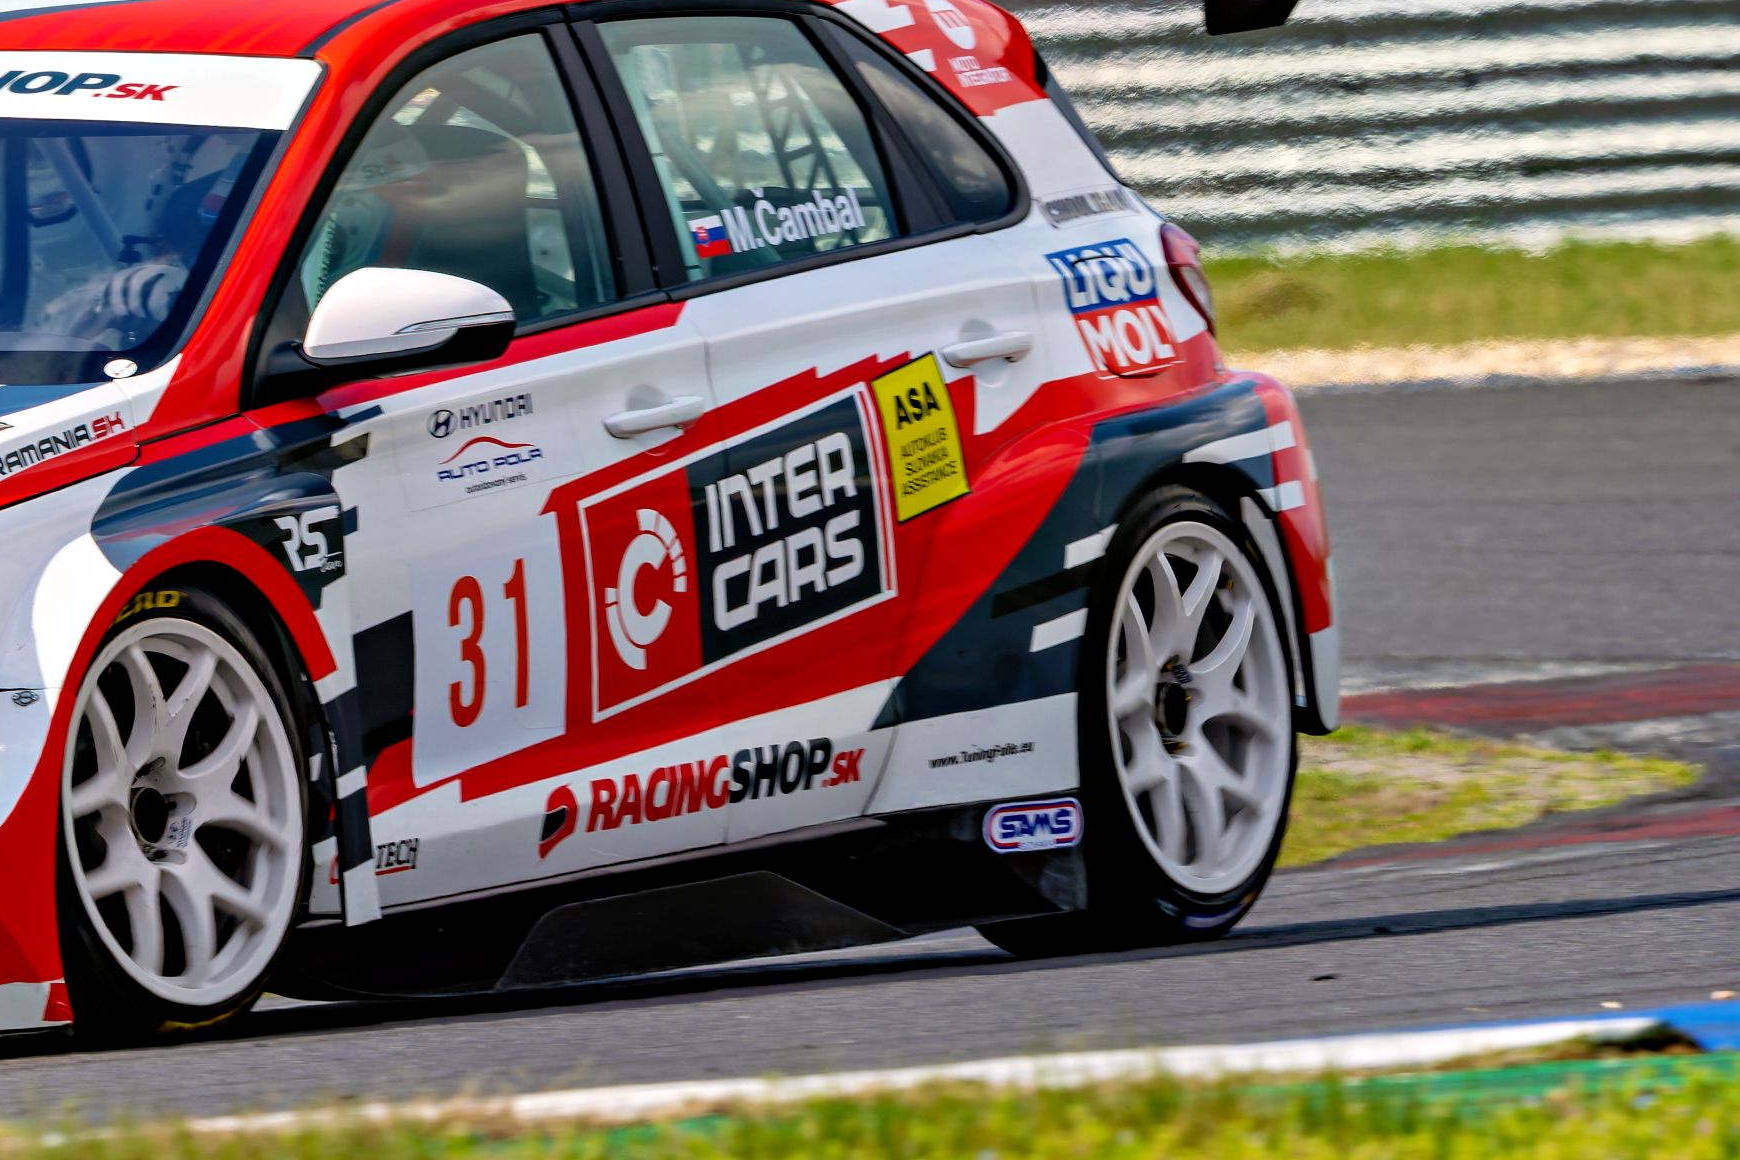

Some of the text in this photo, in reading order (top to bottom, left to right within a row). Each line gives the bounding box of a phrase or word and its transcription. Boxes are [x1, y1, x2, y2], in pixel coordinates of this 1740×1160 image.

[459, 393, 534, 430] HYUNDAI
[893, 381, 942, 430] ASA
[437, 448, 543, 482] AUTO POLA
[704, 432, 858, 552] INTER
[272, 505, 340, 571] RS
[712, 509, 865, 631] CARS
[447, 557, 530, 728] 31
[585, 737, 867, 834] RACINGSHOP.SK
